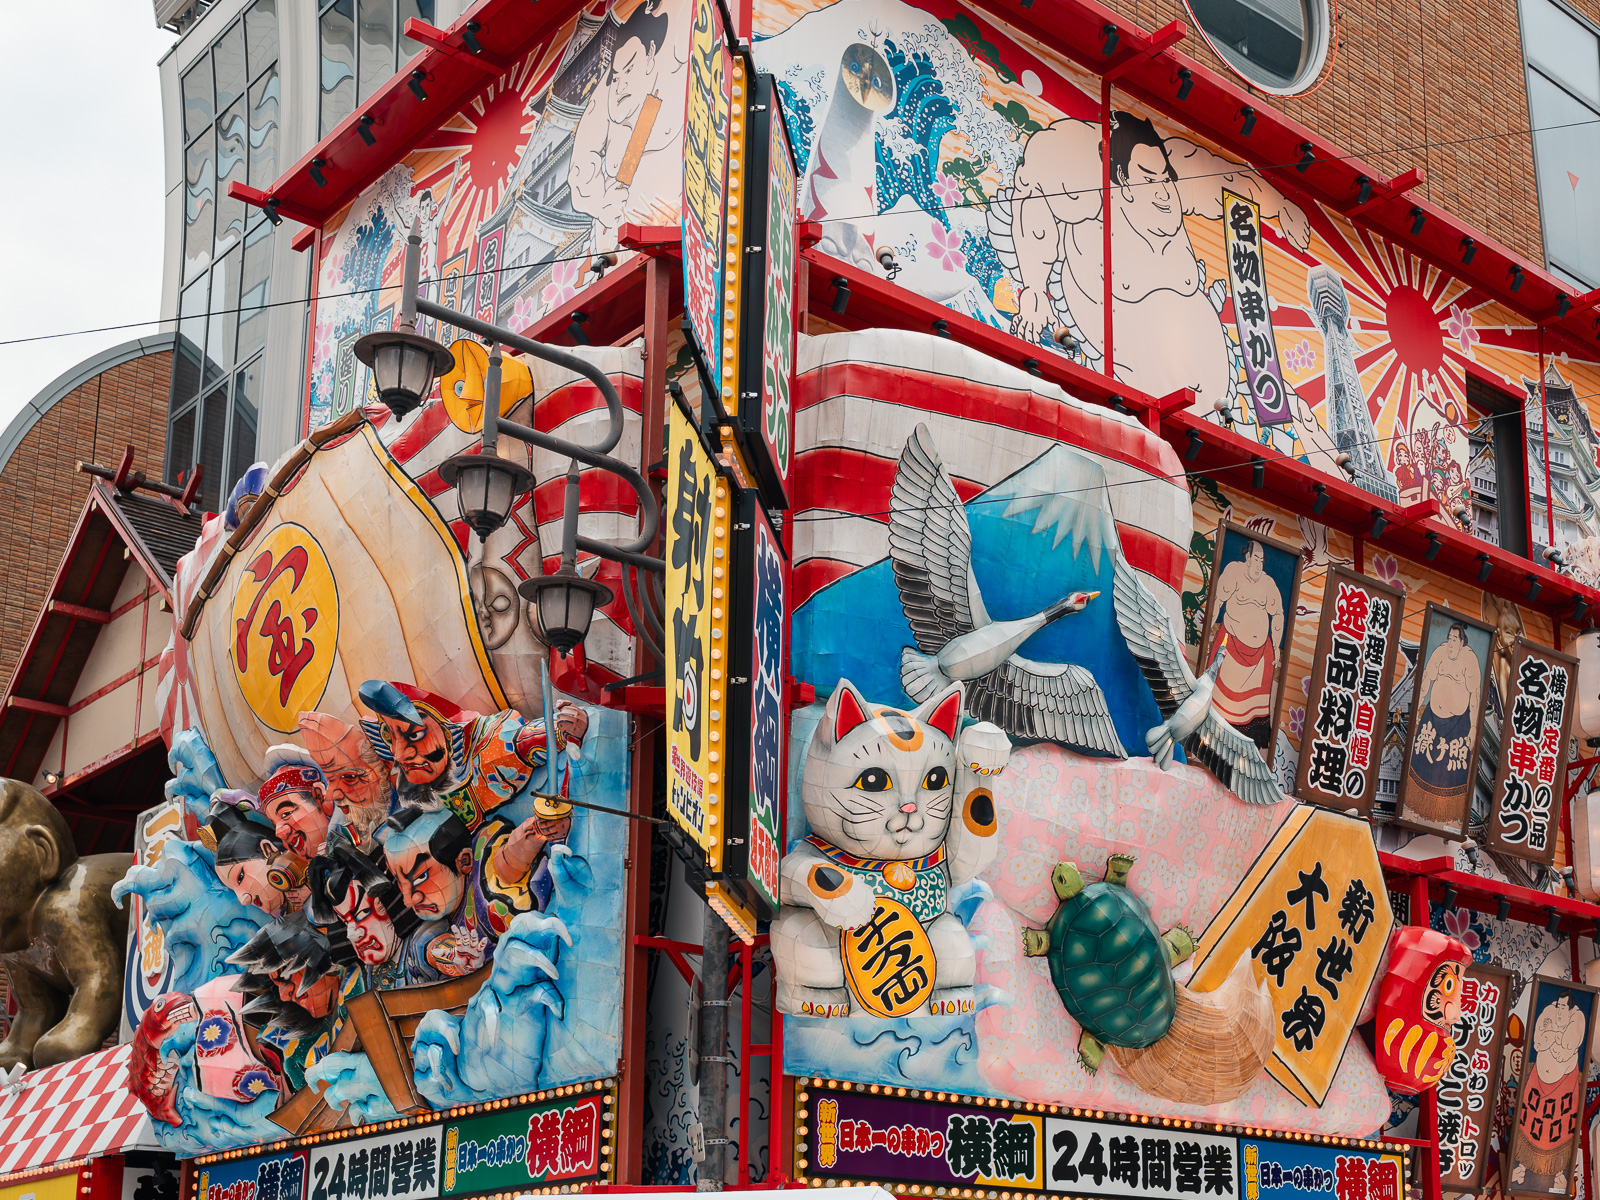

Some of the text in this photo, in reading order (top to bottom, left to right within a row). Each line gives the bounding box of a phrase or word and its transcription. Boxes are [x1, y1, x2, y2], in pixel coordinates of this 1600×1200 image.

[1229, 201, 1283, 413] 名物串かつ
[754, 523, 783, 837] 横綱
[1307, 582, 1370, 797] 逸品料理
[1345, 597, 1391, 799] 料理長自慢の
[1499, 655, 1550, 843] 名物串かつ
[1528, 666, 1568, 850] 横綱定番の一品
[672, 778, 704, 835] チャンピオン
[1251, 861, 1329, 987] 大阪
[1281, 878, 1375, 1053] 新世界
[312, 1136, 436, 1200] 24時間営業
[445, 1127, 458, 1191] 新世界
[457, 1102, 596, 1178] 日本一の串かつ 横綱
[817, 1099, 838, 1168] 新世界
[839, 1114, 1036, 1180] 日本一の串かつ 横綱
[1052, 1130, 1233, 1195] 24時間営業
[1259, 1155, 1398, 1200] 日本一の串かつ 横綱
